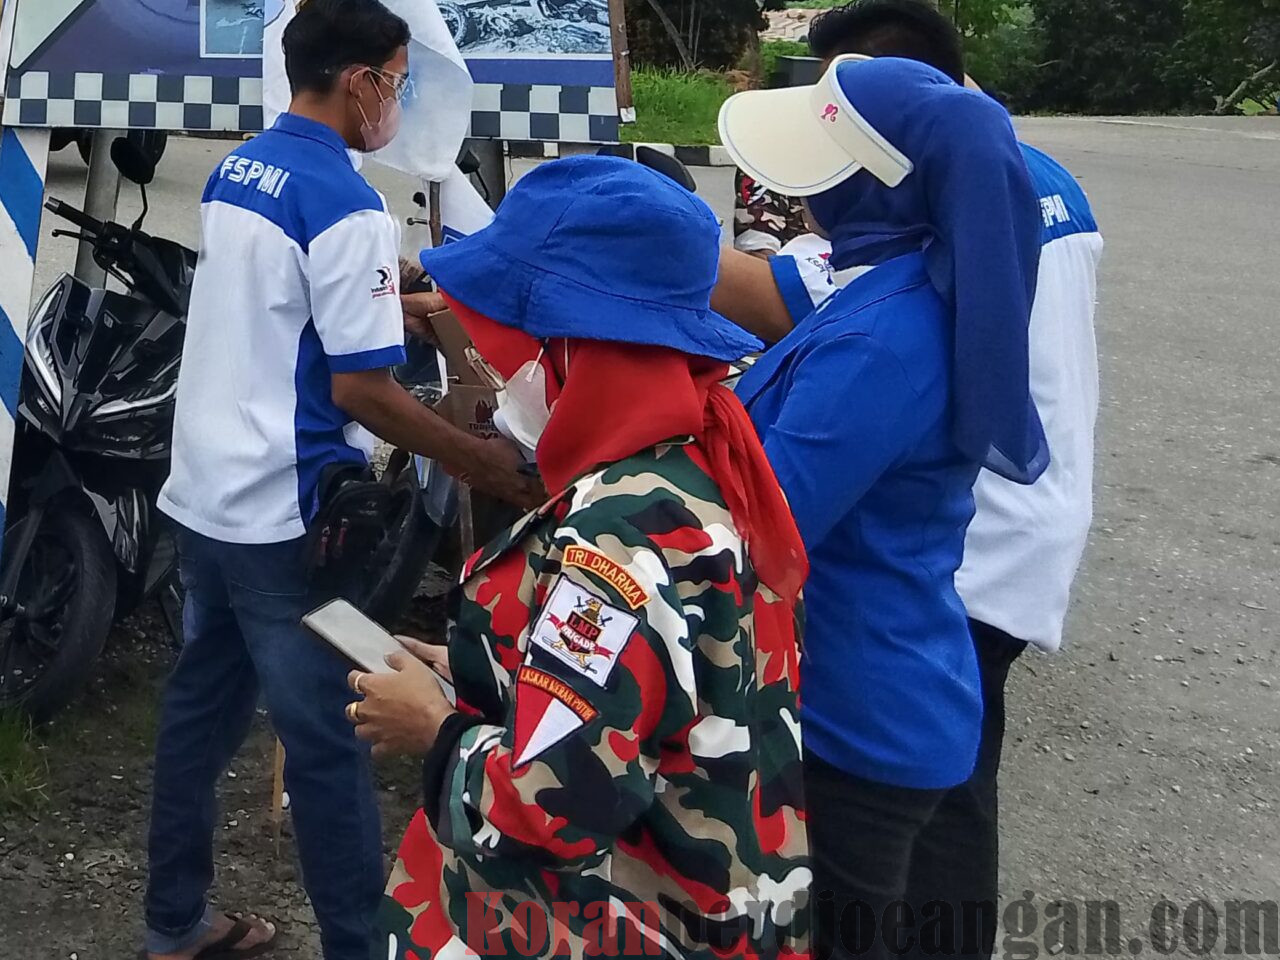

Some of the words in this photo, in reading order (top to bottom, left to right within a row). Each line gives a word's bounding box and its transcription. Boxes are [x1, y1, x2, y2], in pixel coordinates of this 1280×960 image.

[219, 154, 291, 200] FSPMI
[569, 548, 588, 565] TRI
[590, 554, 643, 605] DHARMA
[569, 613, 599, 640] LMP
[520, 667, 550, 689] LASKAR
